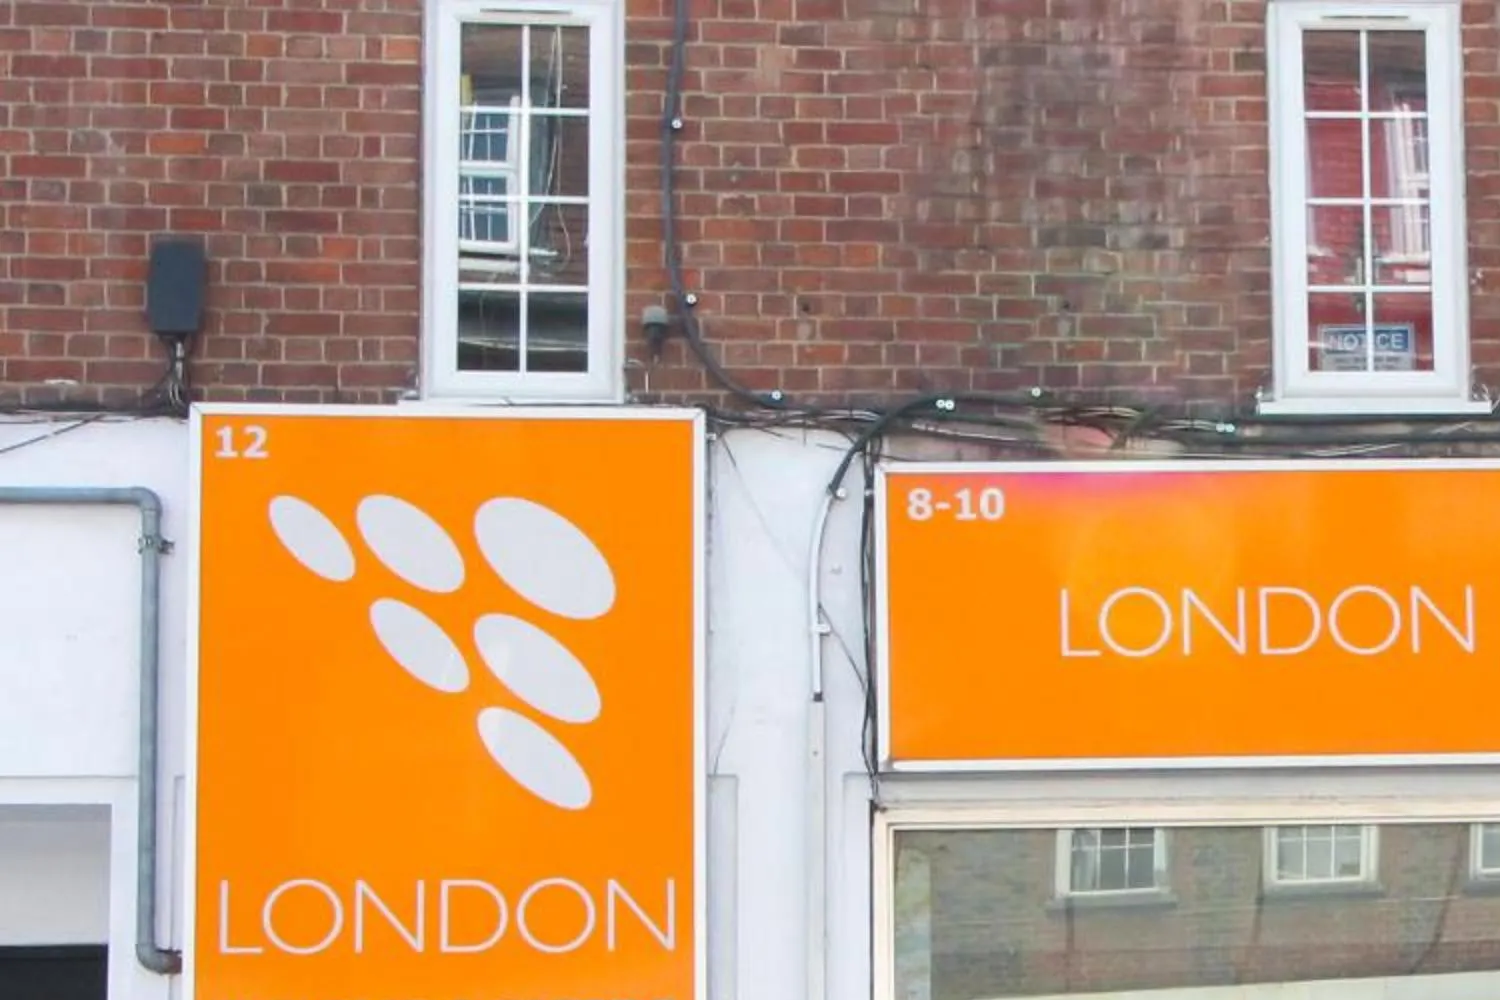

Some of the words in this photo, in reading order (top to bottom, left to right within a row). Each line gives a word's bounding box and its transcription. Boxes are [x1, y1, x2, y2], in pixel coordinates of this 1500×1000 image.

[1328, 333, 1404, 351] NOTCE
[216, 425, 269, 460] 12
[907, 484, 1006, 522] 8-10
[1059, 585, 1477, 659] LONDON
[218, 876, 678, 957] LONDON
